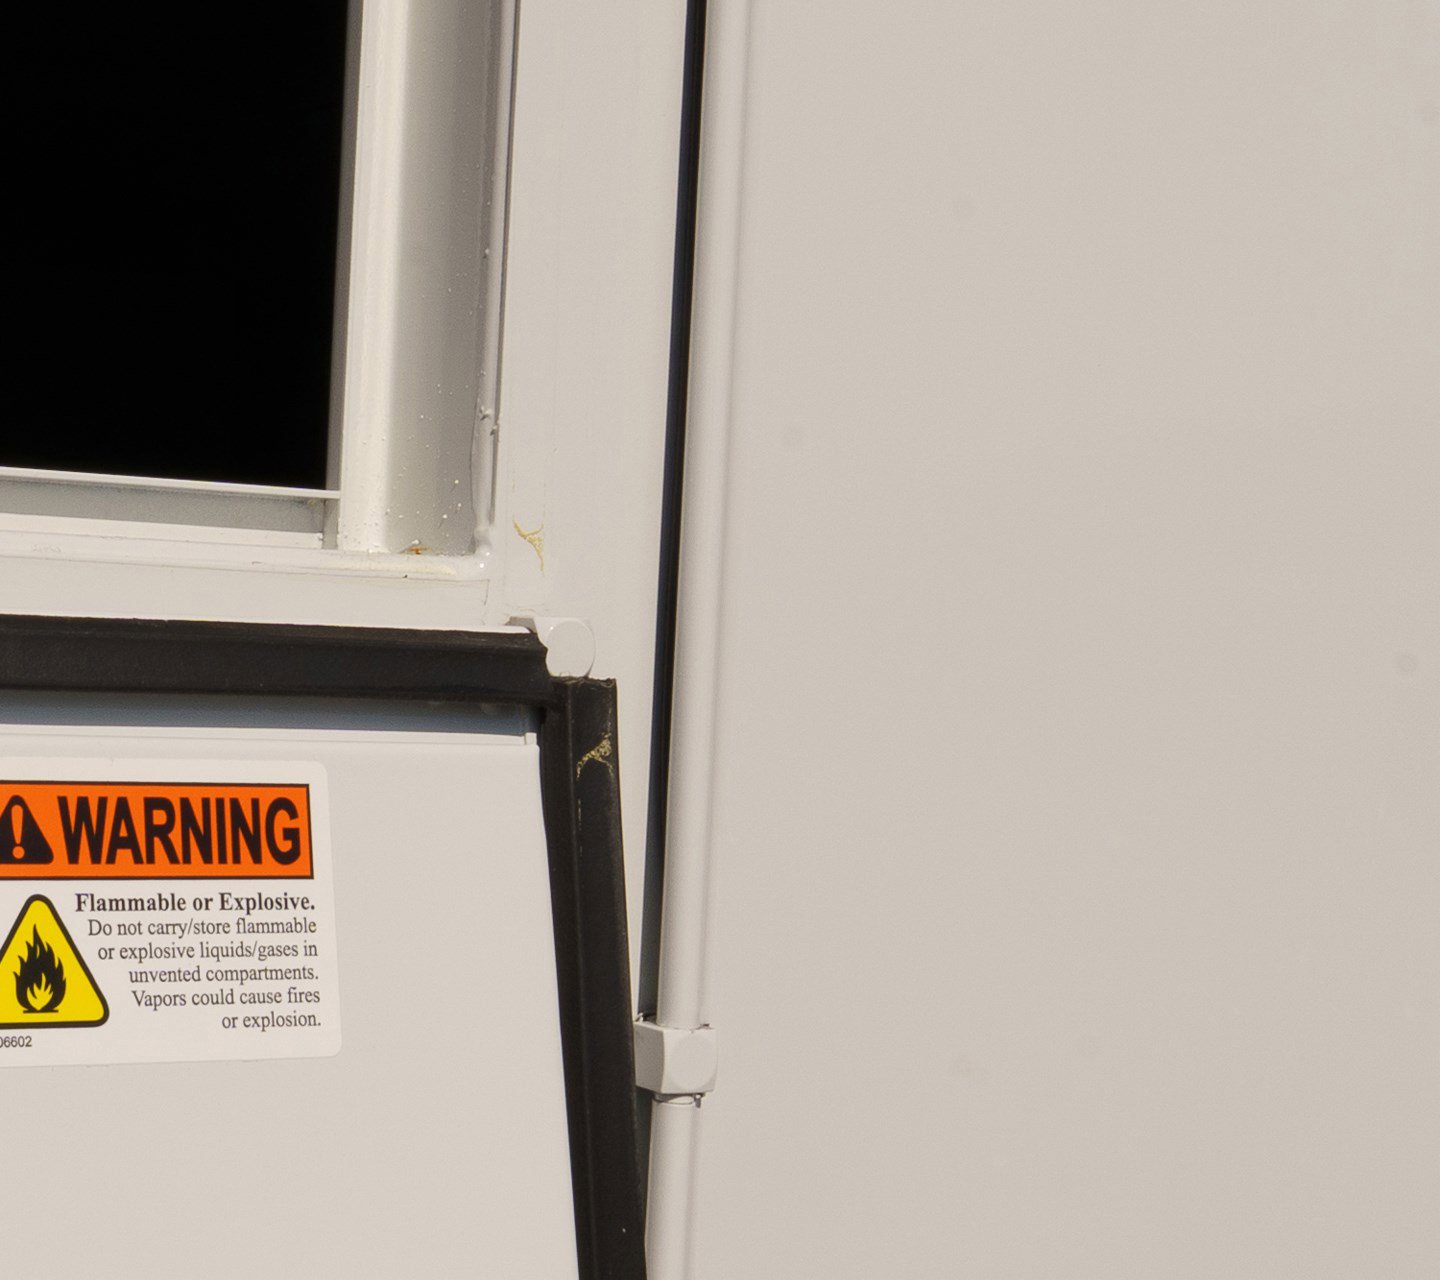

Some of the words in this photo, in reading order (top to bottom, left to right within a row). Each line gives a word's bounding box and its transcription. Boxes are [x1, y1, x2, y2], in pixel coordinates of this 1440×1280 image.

[57, 795, 301, 866] WARNING
[75, 893, 186, 912] Flammable
[192, 897, 214, 911] or
[219, 892, 315, 916] Explosive.
[88, 919, 113, 936] Do
[117, 920, 143, 936] not
[147, 918, 231, 939] carry/store
[236, 917, 317, 934] flammable
[97, 947, 115, 960] or
[119, 942, 195, 964] explosive
[200, 941, 299, 962] liquids/gases
[303, 941, 318, 957] in
[129, 966, 201, 984] unvented
[205, 967, 319, 986] compartments.
[131, 990, 187, 1011] Vapors
[191, 988, 235, 1007] could
[239, 992, 282, 1005] cause
[286, 988, 321, 1004] fires
[221, 1016, 239, 1029] or
[242, 1011, 321, 1032] explosion.
